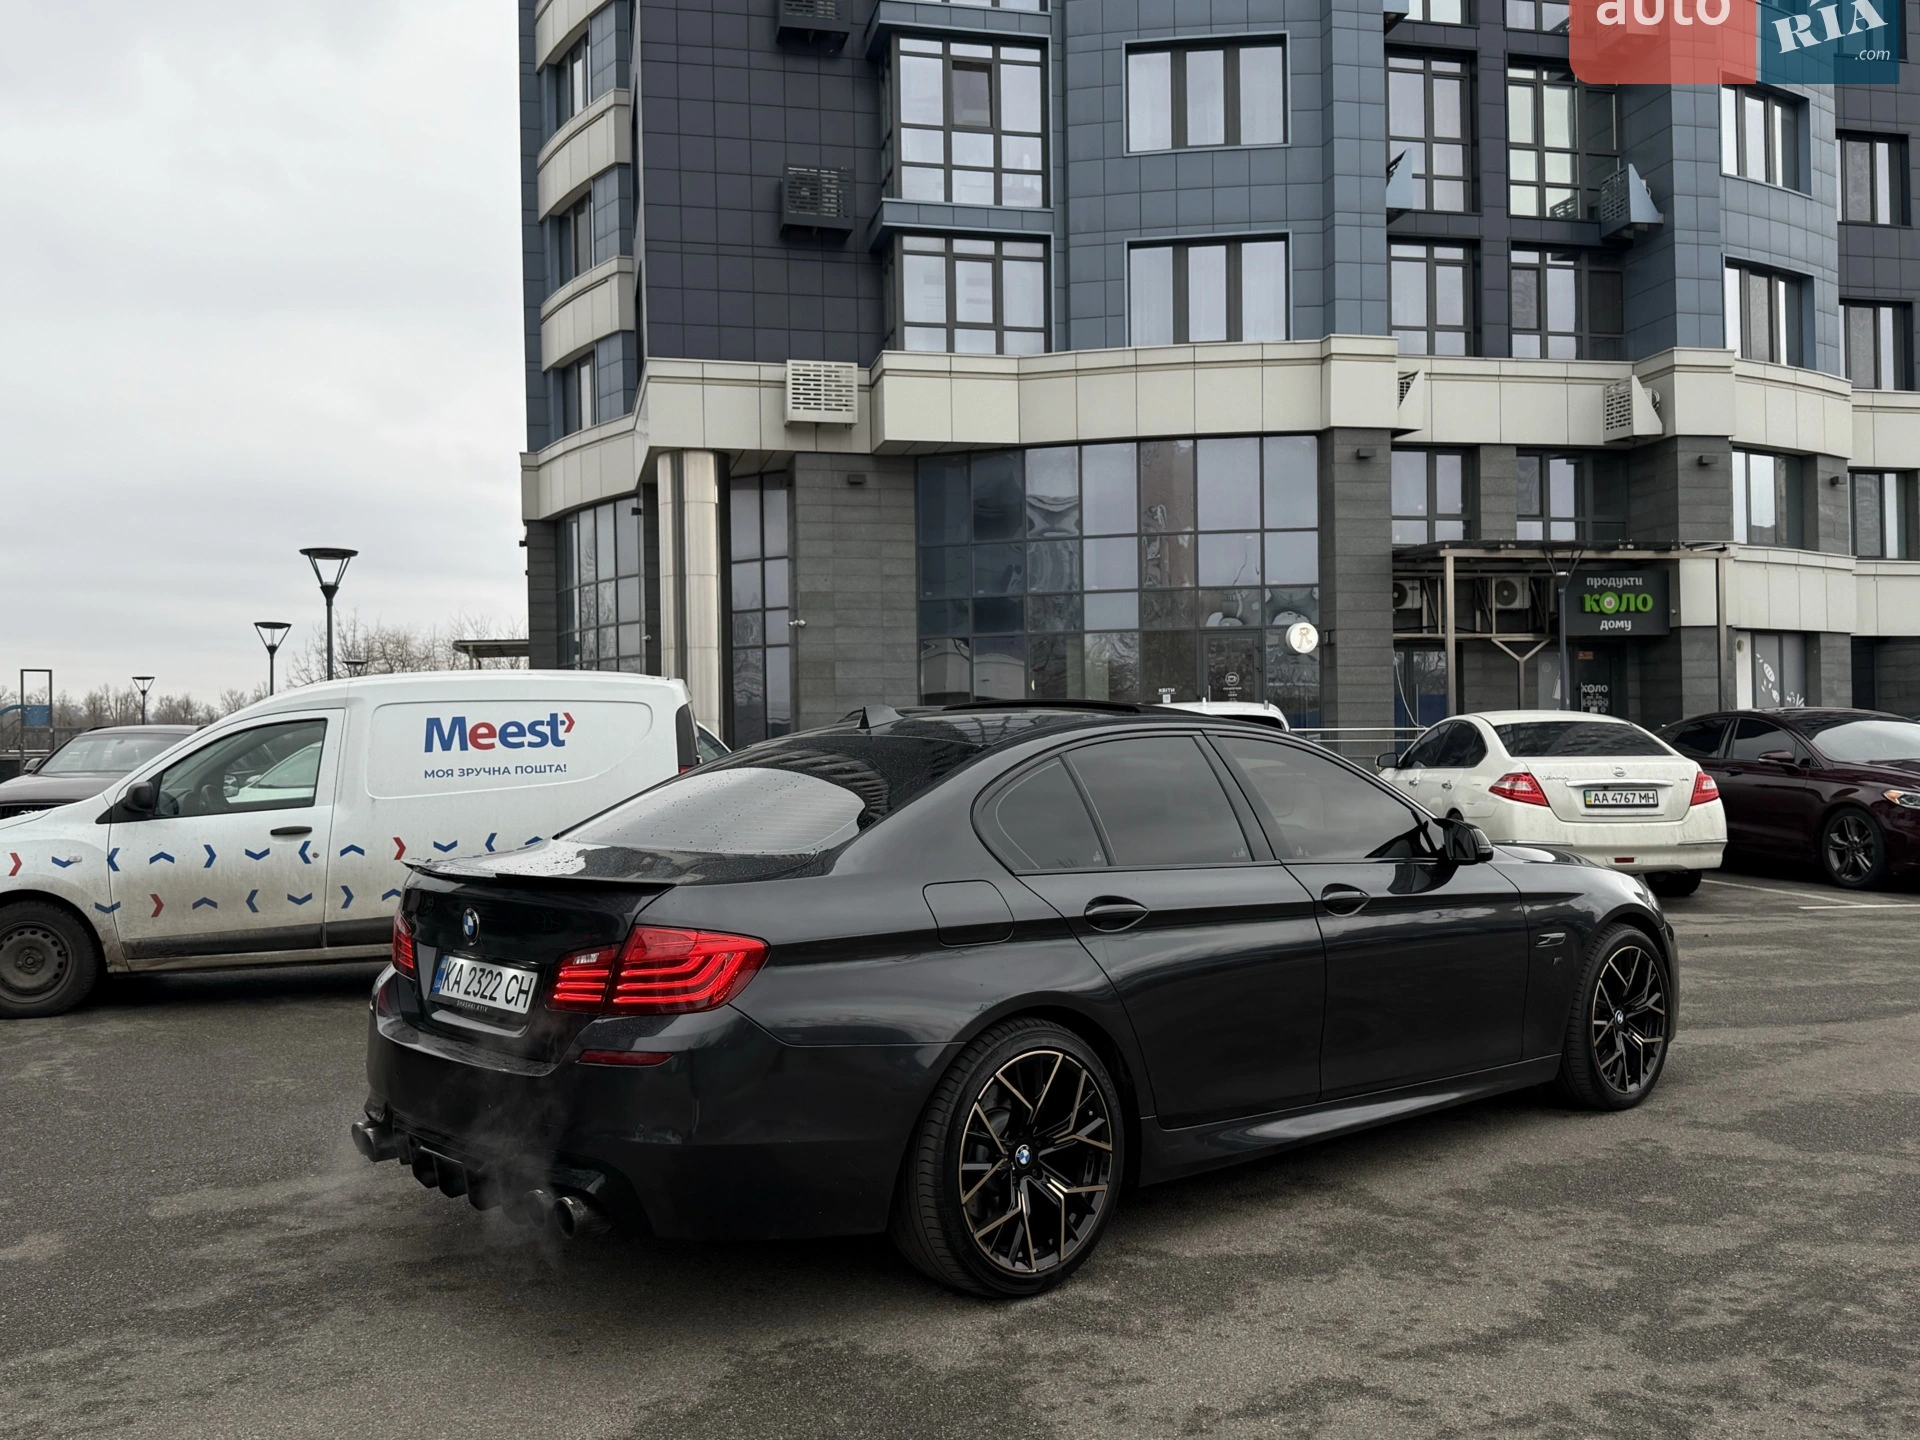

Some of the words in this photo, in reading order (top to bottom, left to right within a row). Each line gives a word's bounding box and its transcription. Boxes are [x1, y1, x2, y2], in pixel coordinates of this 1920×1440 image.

[1586, 576, 1643, 589] продукти
[1600, 619, 1632, 632] дому
[424, 713, 566, 753] Meest
[424, 769, 454, 779] МОЯ
[458, 766, 511, 777] ЗРУЧНА
[515, 764, 567, 774] ПОШТА!
[1594, 793, 1609, 803] AA
[1611, 792, 1636, 803] 4767
[1638, 792, 1655, 803] MH
[442, 961, 464, 993] KA
[463, 966, 503, 1001] 2322
[504, 974, 533, 1008] CH
